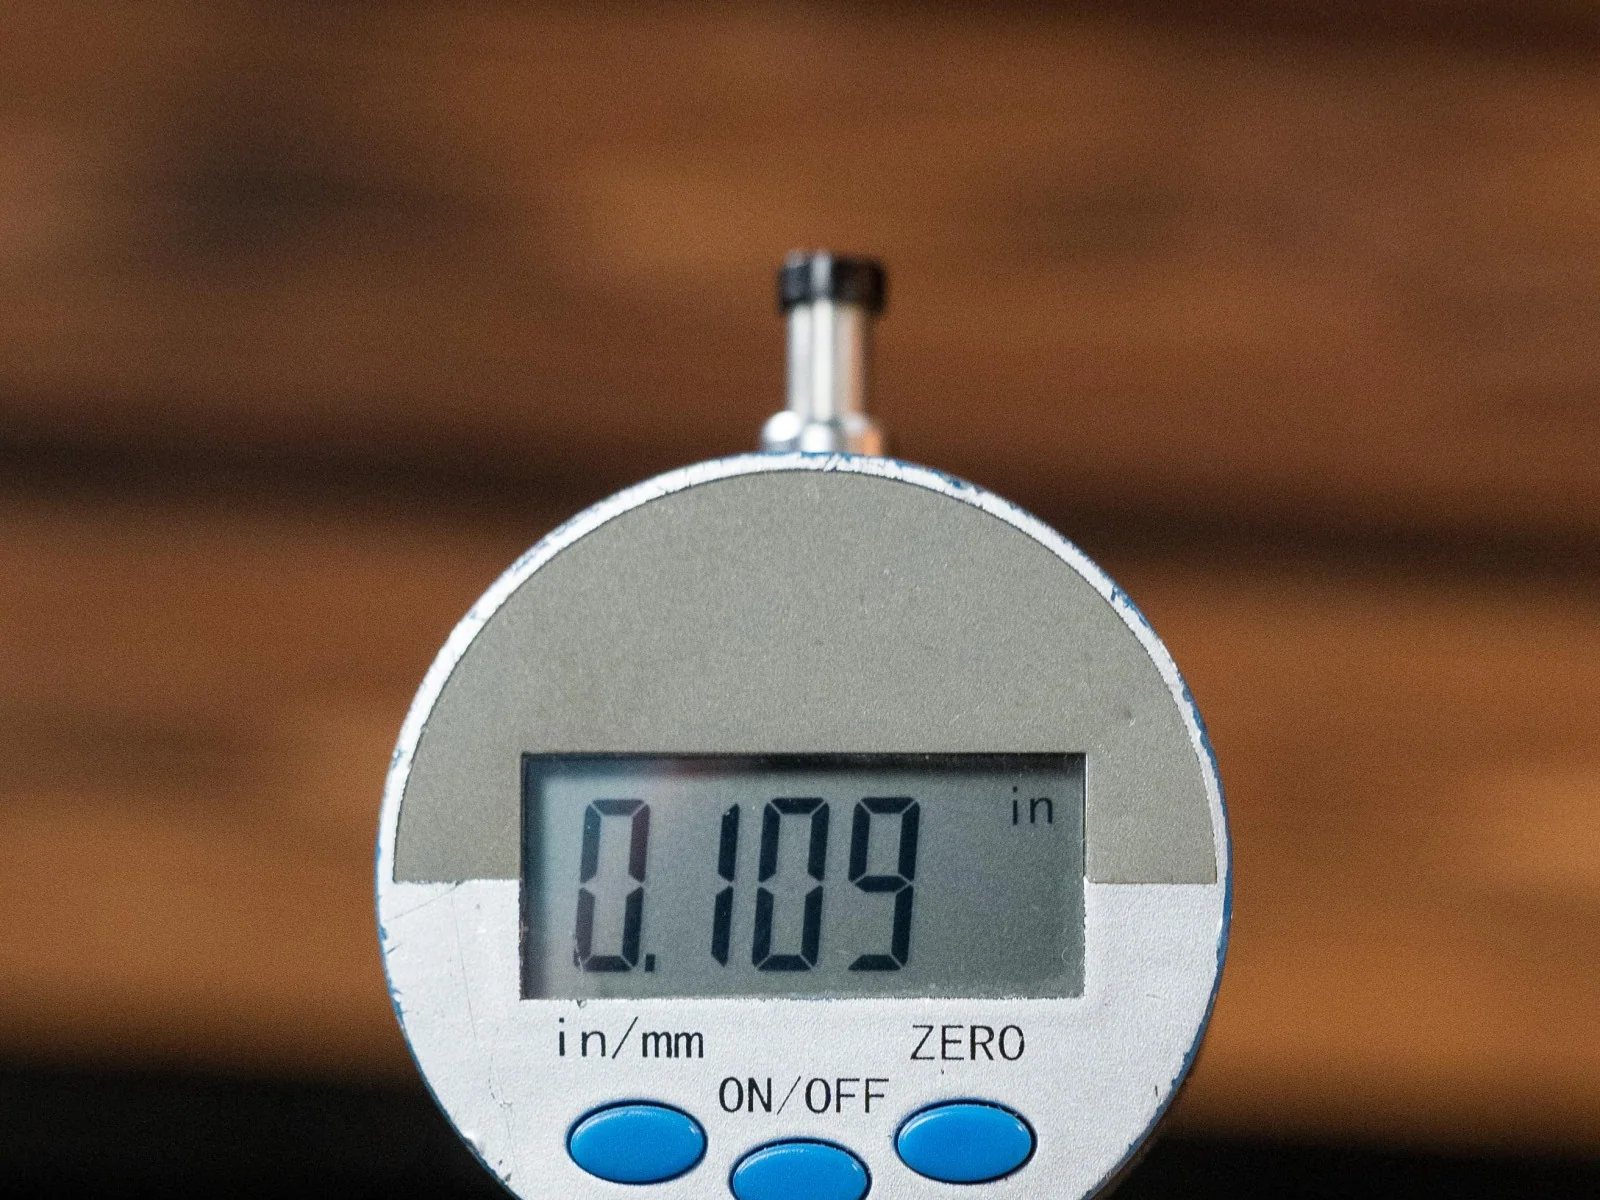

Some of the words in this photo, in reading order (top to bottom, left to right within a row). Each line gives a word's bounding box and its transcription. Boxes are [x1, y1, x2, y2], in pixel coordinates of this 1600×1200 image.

[1011, 786, 1054, 826] in
[573, 797, 921, 973] 0.109
[557, 1016, 705, 1059] in/mm
[909, 1024, 1026, 1061] ZERO
[718, 1076, 890, 1115] ON/OFF
